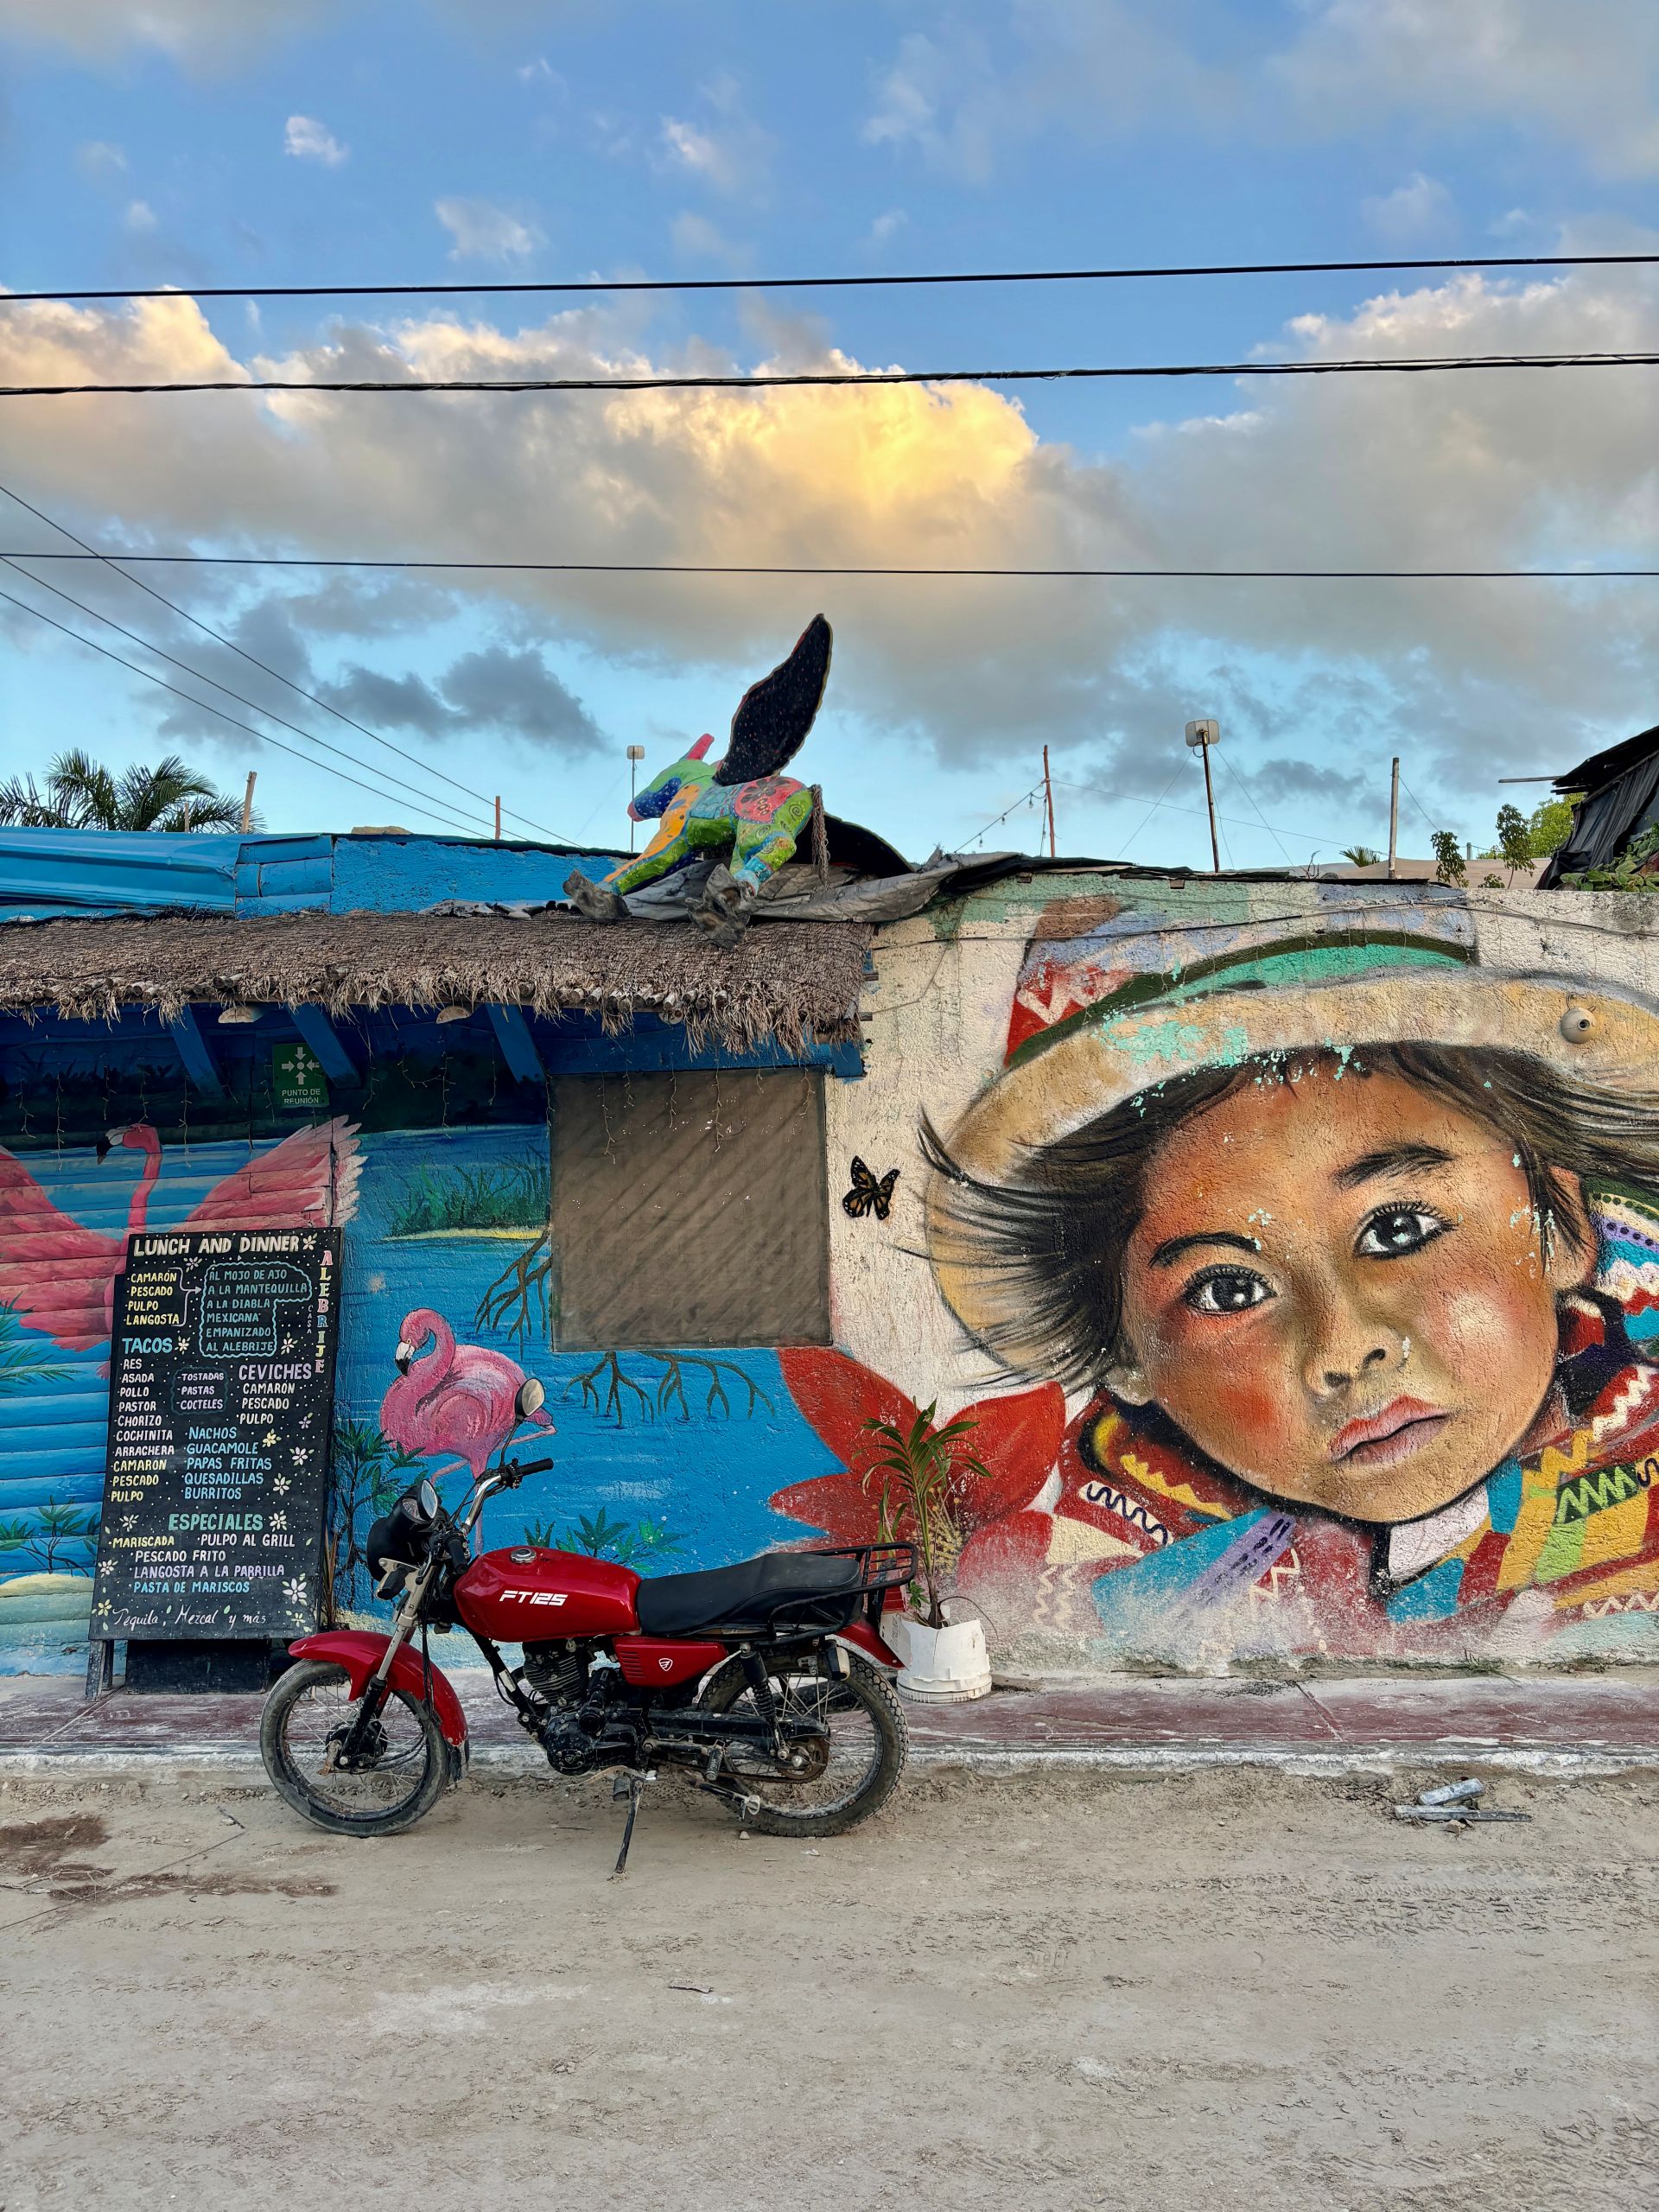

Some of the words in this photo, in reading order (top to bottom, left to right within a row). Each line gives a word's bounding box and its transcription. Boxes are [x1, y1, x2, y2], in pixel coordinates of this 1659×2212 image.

[133, 1238, 191, 1256] LUNCH
[198, 1238, 232, 1254] AND
[239, 1236, 300, 1253] DINNER
[130, 1270, 177, 1283] CAMARÓN
[209, 1270, 220, 1281] AL
[225, 1269, 251, 1280] MOJO
[254, 1269, 265, 1280] DE
[267, 1269, 288, 1280] AJO
[130, 1286, 173, 1297] PESCADO
[207, 1285, 215, 1295] A
[219, 1285, 231, 1294] LA
[236, 1282, 308, 1294] MANTEQUILLA
[128, 1300, 159, 1311] PULPO
[207, 1300, 213, 1309] A
[216, 1300, 228, 1309] LA
[232, 1299, 270, 1309] DIABLA
[126, 1313, 180, 1326] LANGOSTA
[207, 1313, 259, 1323] MEXICANA
[206, 1327, 271, 1338] EMPANIZADO
[122, 1338, 173, 1355] TACOS
[206, 1342, 219, 1352] AL
[222, 1341, 274, 1352] ALEBRIJE
[123, 1358, 143, 1370] RES
[121, 1373, 155, 1383] ASADA
[238, 1363, 312, 1381] CEVICHES
[119, 1387, 149, 1397] POLLO
[242, 1382, 296, 1395] CAMARÓN
[118, 1401, 157, 1412] PASTOR
[242, 1397, 289, 1409] PESCADO
[118, 1415, 162, 1427] CHORIZO
[239, 1413, 274, 1425] PULPO
[116, 1430, 174, 1442] COCHINITA
[188, 1426, 238, 1440] NACHOS
[115, 1445, 175, 1457] ARRACHERA
[186, 1442, 258, 1455] GUACAMOLE
[113, 1458, 168, 1471] CAMARÓN
[187, 1458, 222, 1470] PAPAS
[230, 1457, 272, 1470] FRITAS
[112, 1474, 160, 1486] PESCADO
[184, 1472, 264, 1485] QUESADILLAS
[111, 1491, 143, 1503] PULPO
[184, 1487, 242, 1500] BURRITOS
[168, 1513, 264, 1532] ESPECIALES
[112, 1535, 175, 1548] MARISCADA
[200, 1534, 238, 1547] PULPO
[242, 1534, 257, 1547] AL
[262, 1535, 296, 1548] GRILL
[135, 1550, 188, 1563] PESCADO
[192, 1550, 226, 1562] FRITO
[134, 1566, 194, 1579] LANGOSTA
[200, 1566, 209, 1578] A
[215, 1566, 229, 1578] LA
[234, 1564, 285, 1578] PARRILLA
[133, 1581, 170, 1593] PASTA
[174, 1581, 186, 1592] DE
[191, 1581, 251, 1593] MARISCOS
[499, 1590, 569, 1606] FT125
[175, 1605, 219, 1624] Mezcal
[228, 1613, 236, 1631] y
